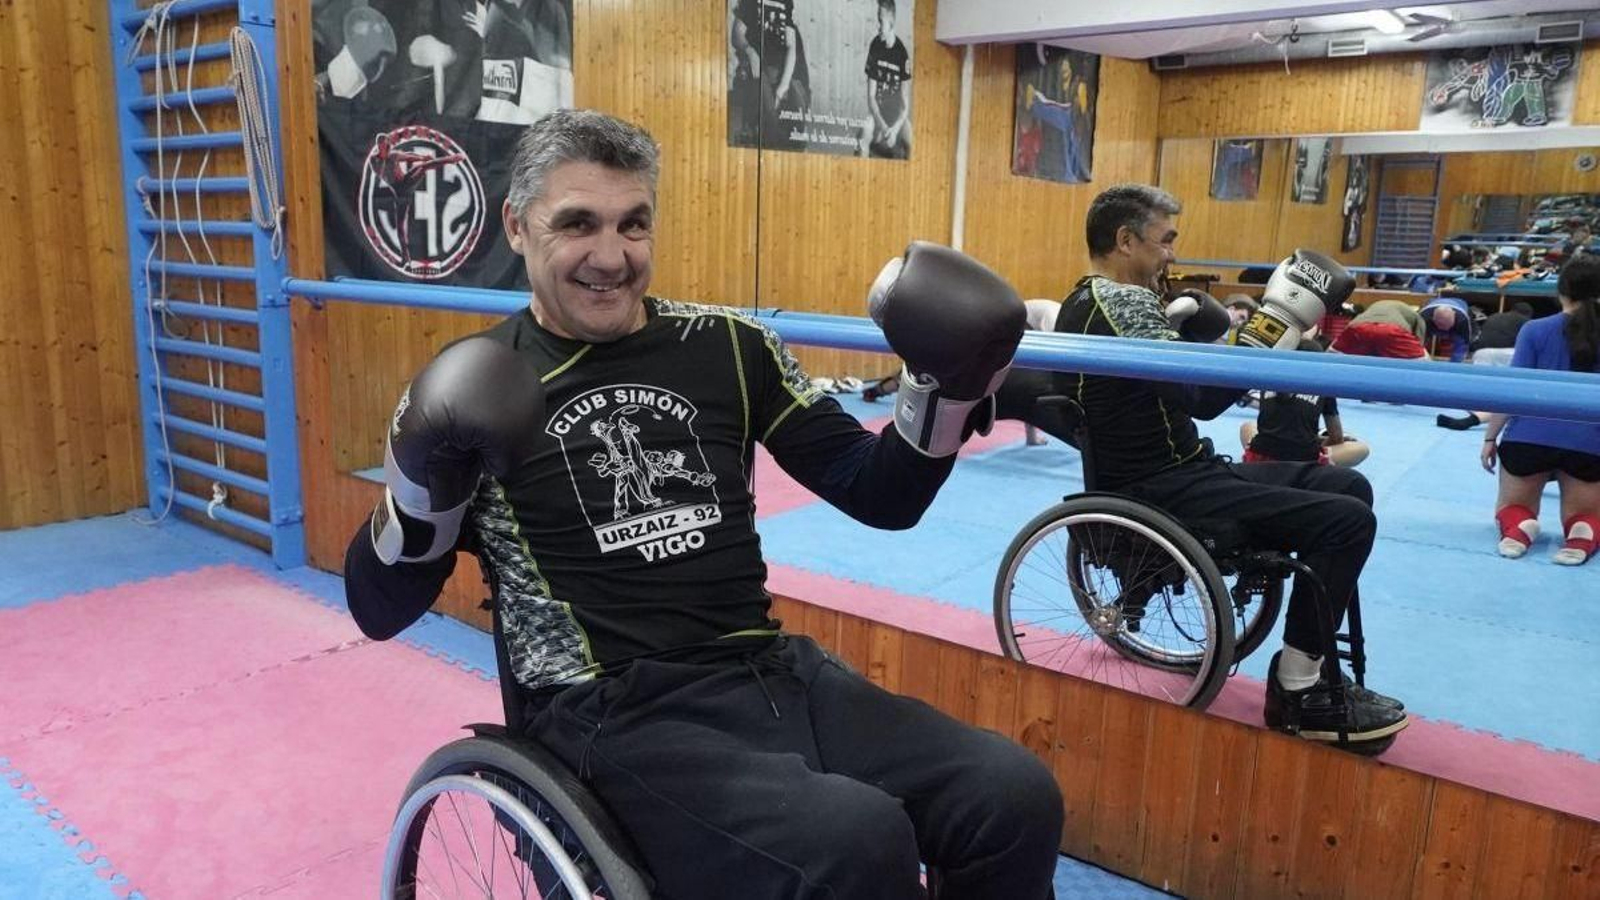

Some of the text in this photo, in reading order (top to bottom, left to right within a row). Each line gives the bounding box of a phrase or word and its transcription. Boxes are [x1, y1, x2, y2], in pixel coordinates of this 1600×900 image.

[554, 389, 690, 435] CLUB SIMÓN
[602, 513, 678, 545] URZAIZ
[693, 505, 719, 521] 92
[637, 530, 706, 562] VIGO
